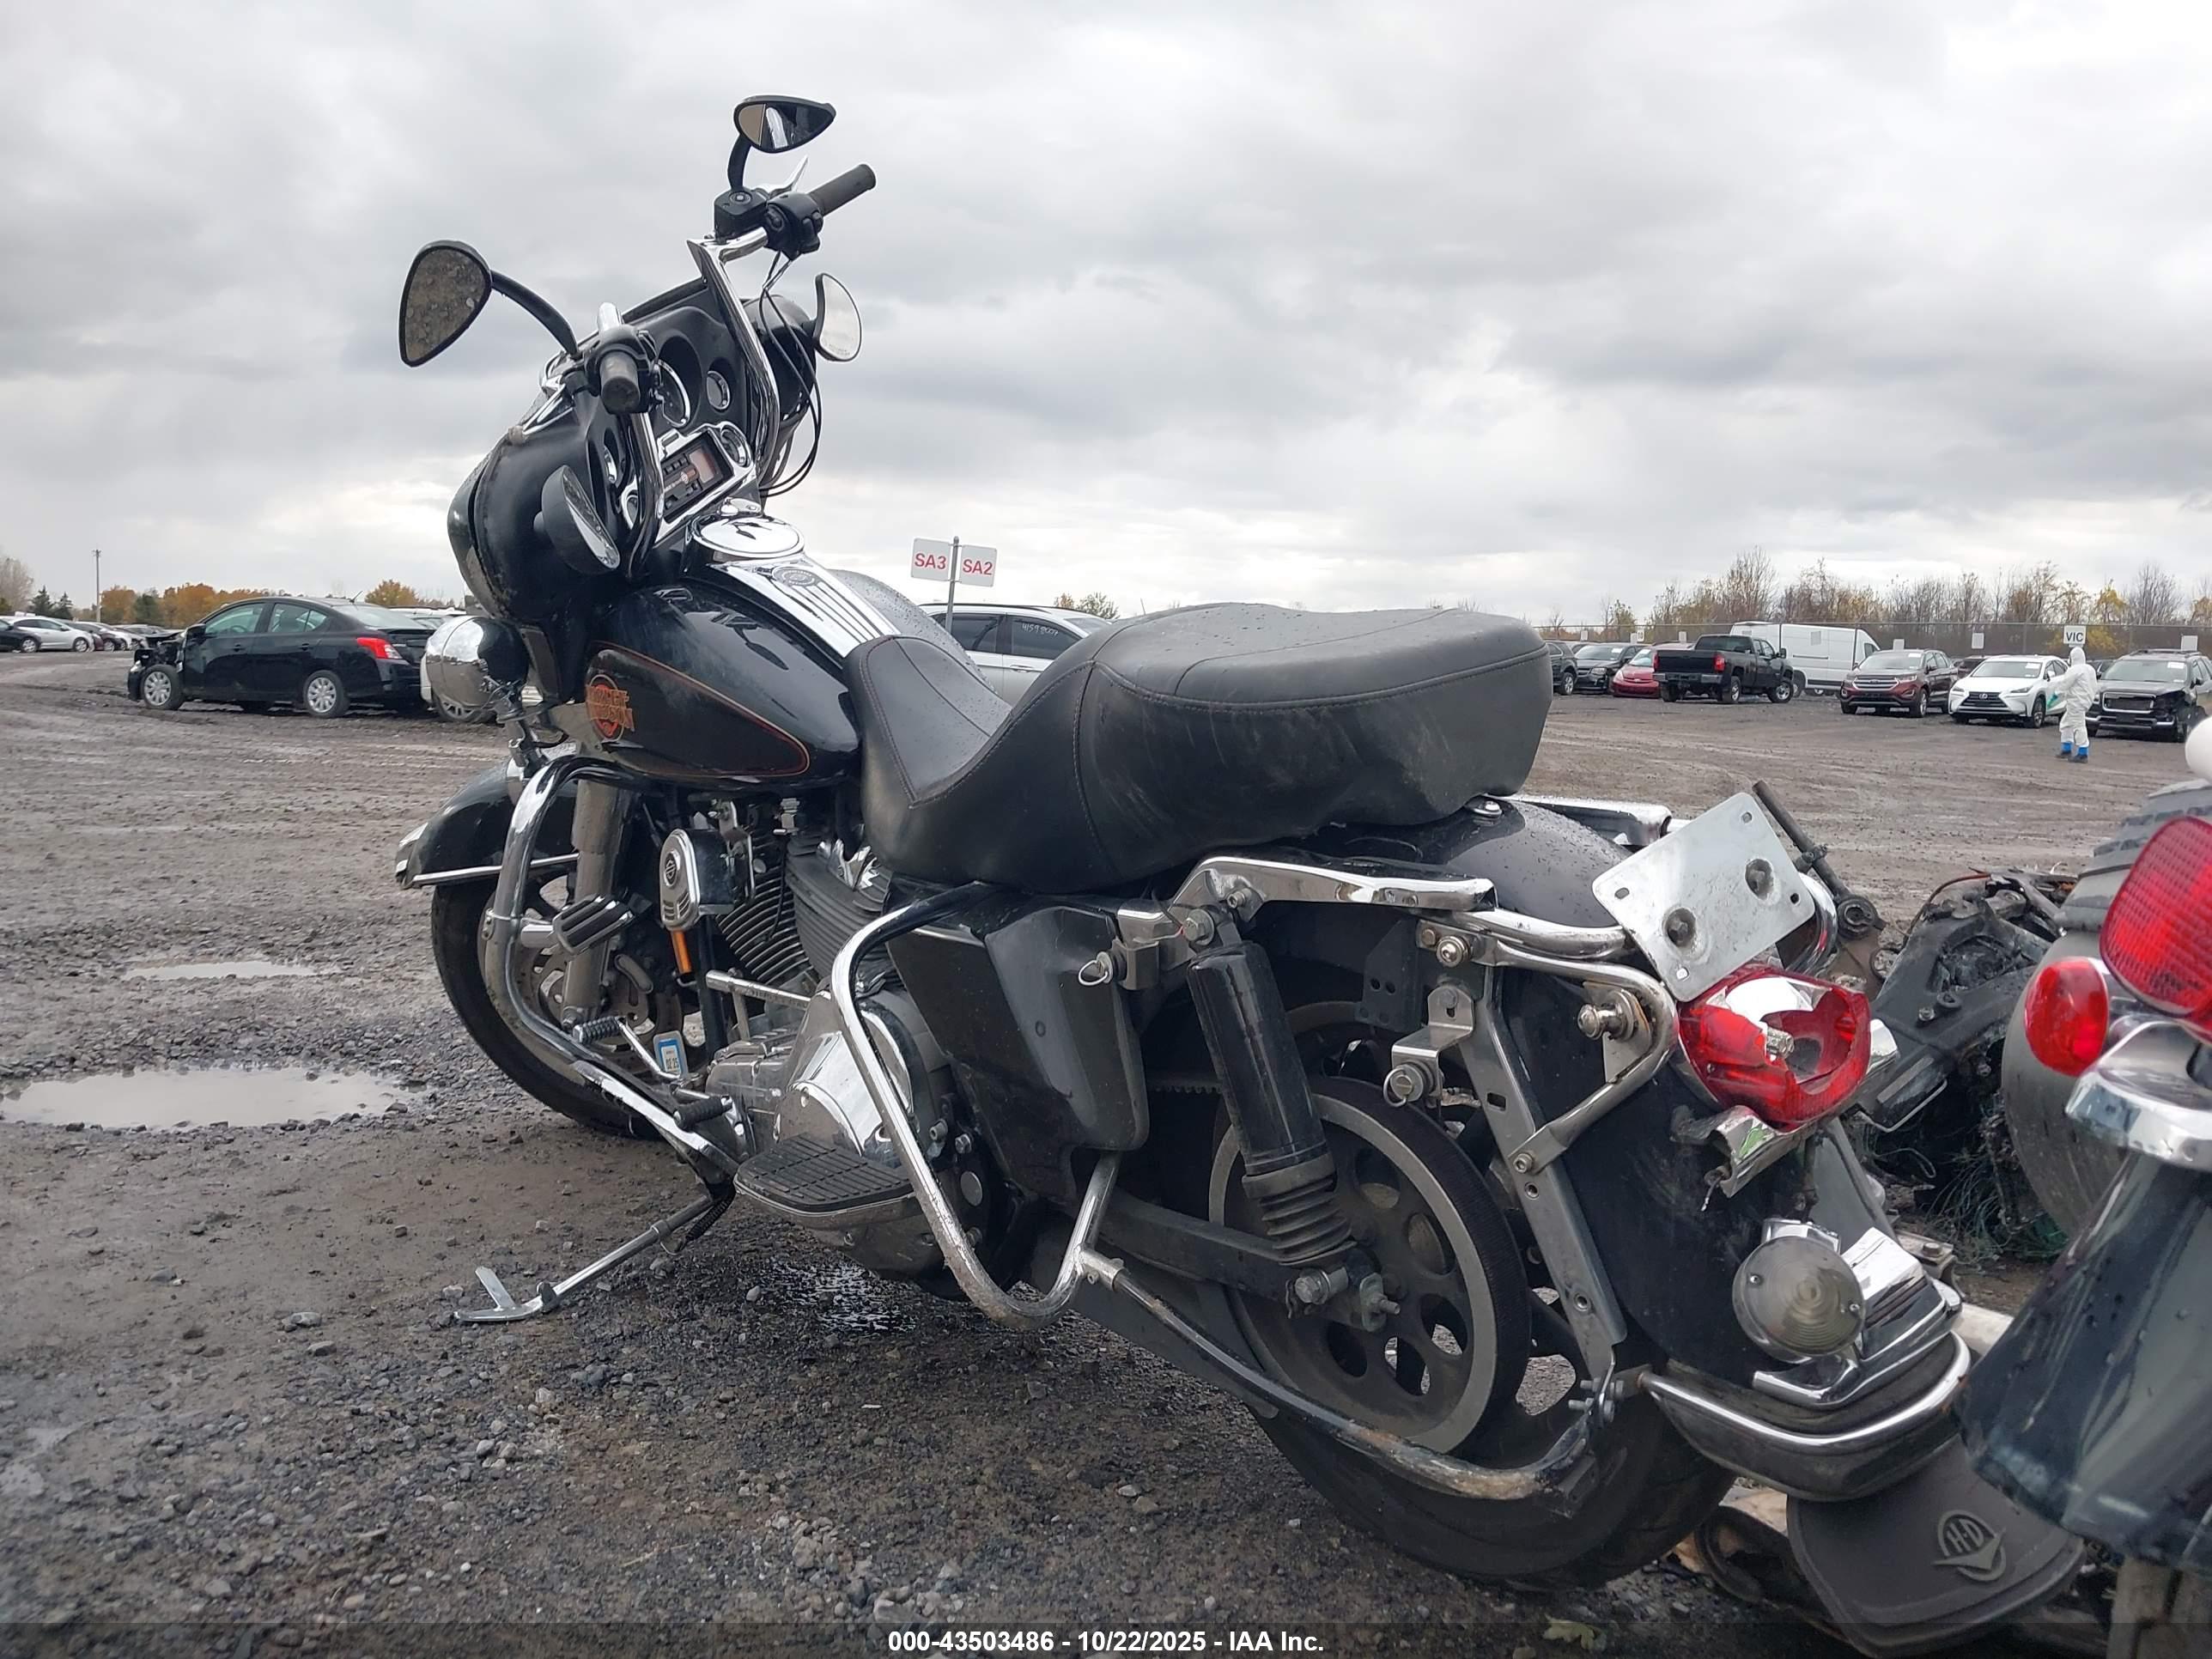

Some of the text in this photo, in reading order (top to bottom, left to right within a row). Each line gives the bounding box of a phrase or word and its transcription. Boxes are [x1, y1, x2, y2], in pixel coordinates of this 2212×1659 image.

[915, 553, 946, 569] SA3
[963, 559, 993, 575] SA2
[2066, 632, 2083, 642] VIC
